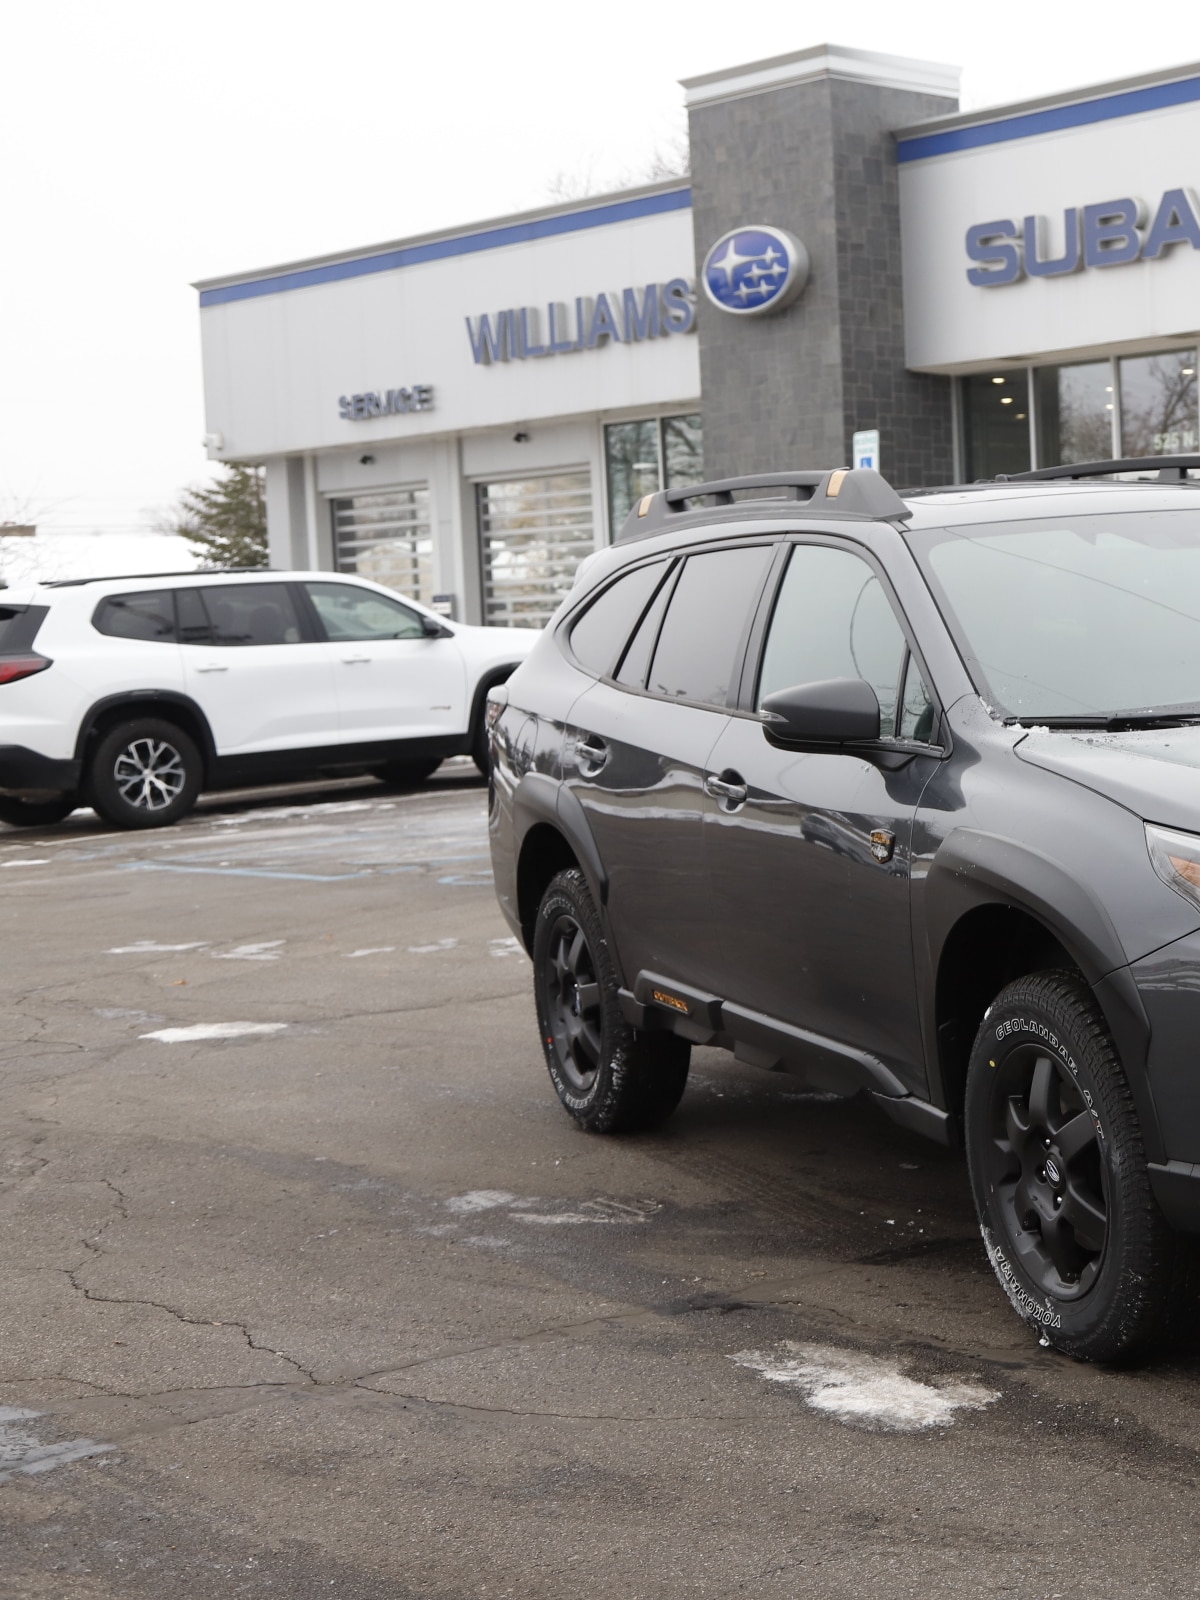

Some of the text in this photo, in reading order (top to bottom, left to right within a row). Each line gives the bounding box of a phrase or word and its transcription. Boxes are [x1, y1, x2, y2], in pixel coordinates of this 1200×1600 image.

[465, 277, 697, 365] WILLIAMS
[338, 384, 435, 420] SERVICE
[1153, 432, 1179, 451] 525
[1183, 430, 1199, 448] N.
[995, 1018, 1105, 1139] GEOLANDAR A/T
[994, 1245, 1062, 1328] YOKOHAMA
